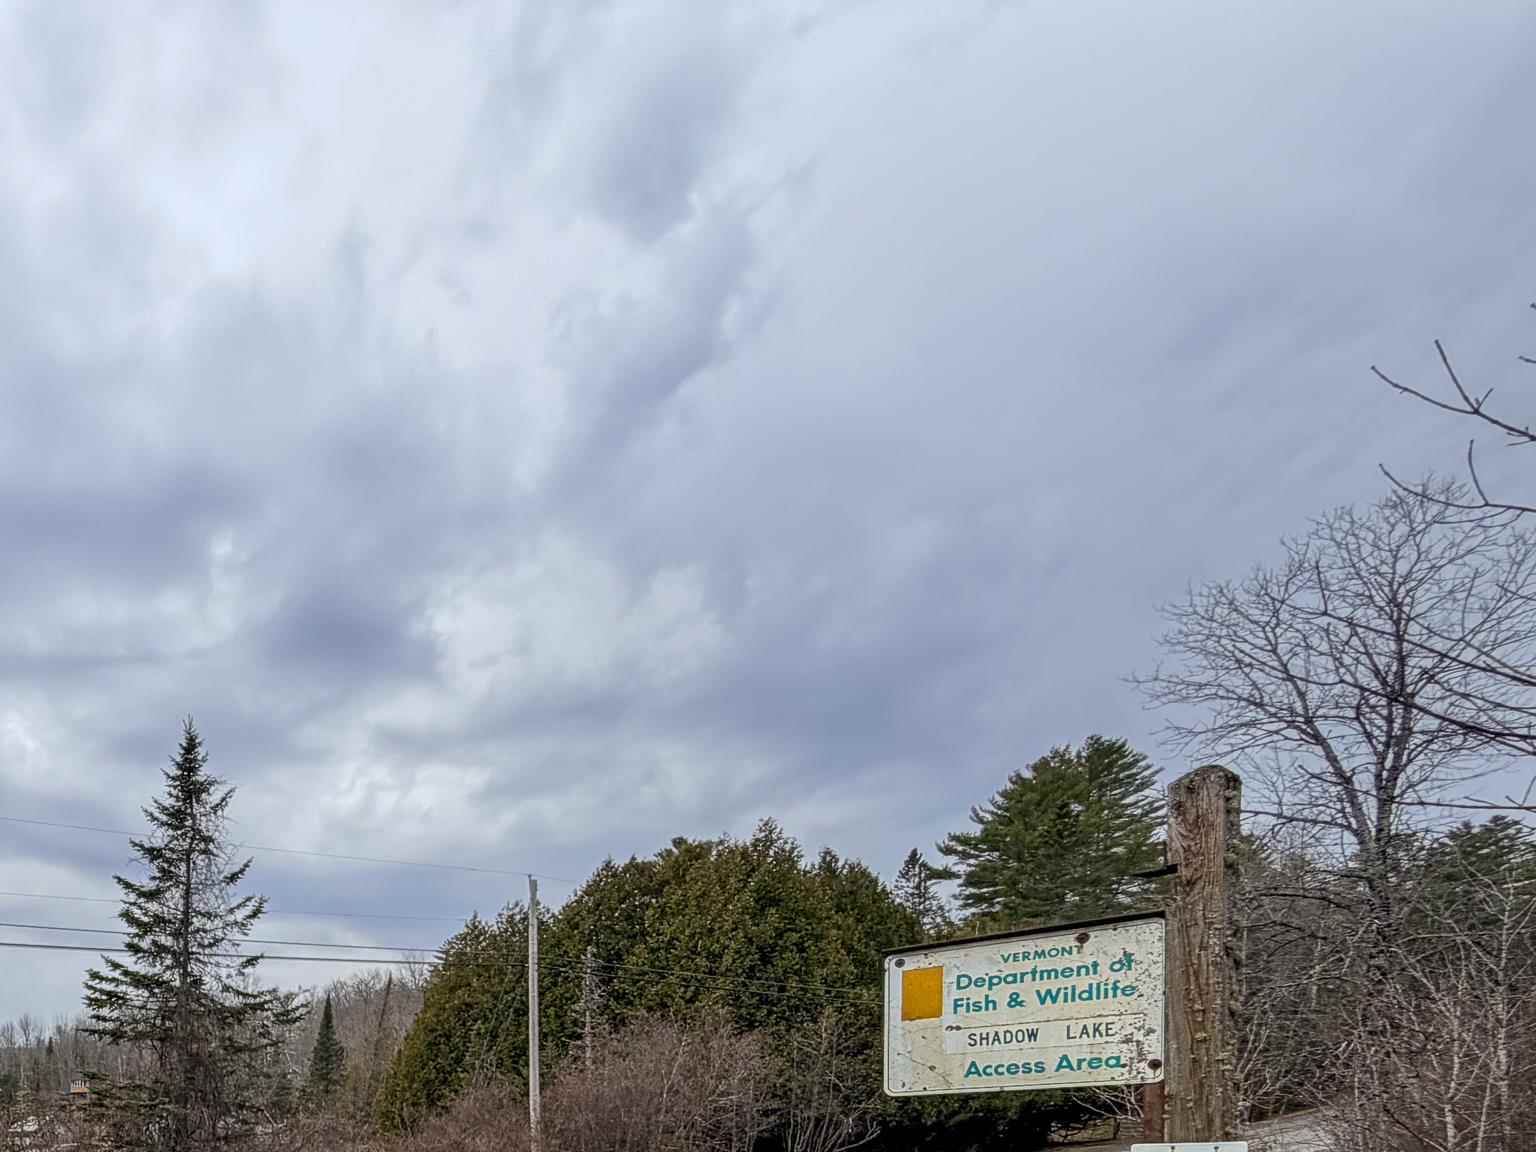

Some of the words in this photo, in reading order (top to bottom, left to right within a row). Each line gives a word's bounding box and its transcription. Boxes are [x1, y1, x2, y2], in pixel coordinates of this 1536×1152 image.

[1000, 944, 1083, 963] VERMONT
[956, 960, 1099, 991] Department
[1109, 952, 1135, 973] of
[952, 992, 998, 1015] Fish
[1006, 991, 1027, 1008] &
[1035, 979, 1137, 1006] Wildlife
[967, 1027, 1040, 1047] SHADOW
[1066, 1021, 1116, 1041] LAKE
[964, 1057, 1045, 1078] Access
[1054, 1053, 1123, 1073] Area
